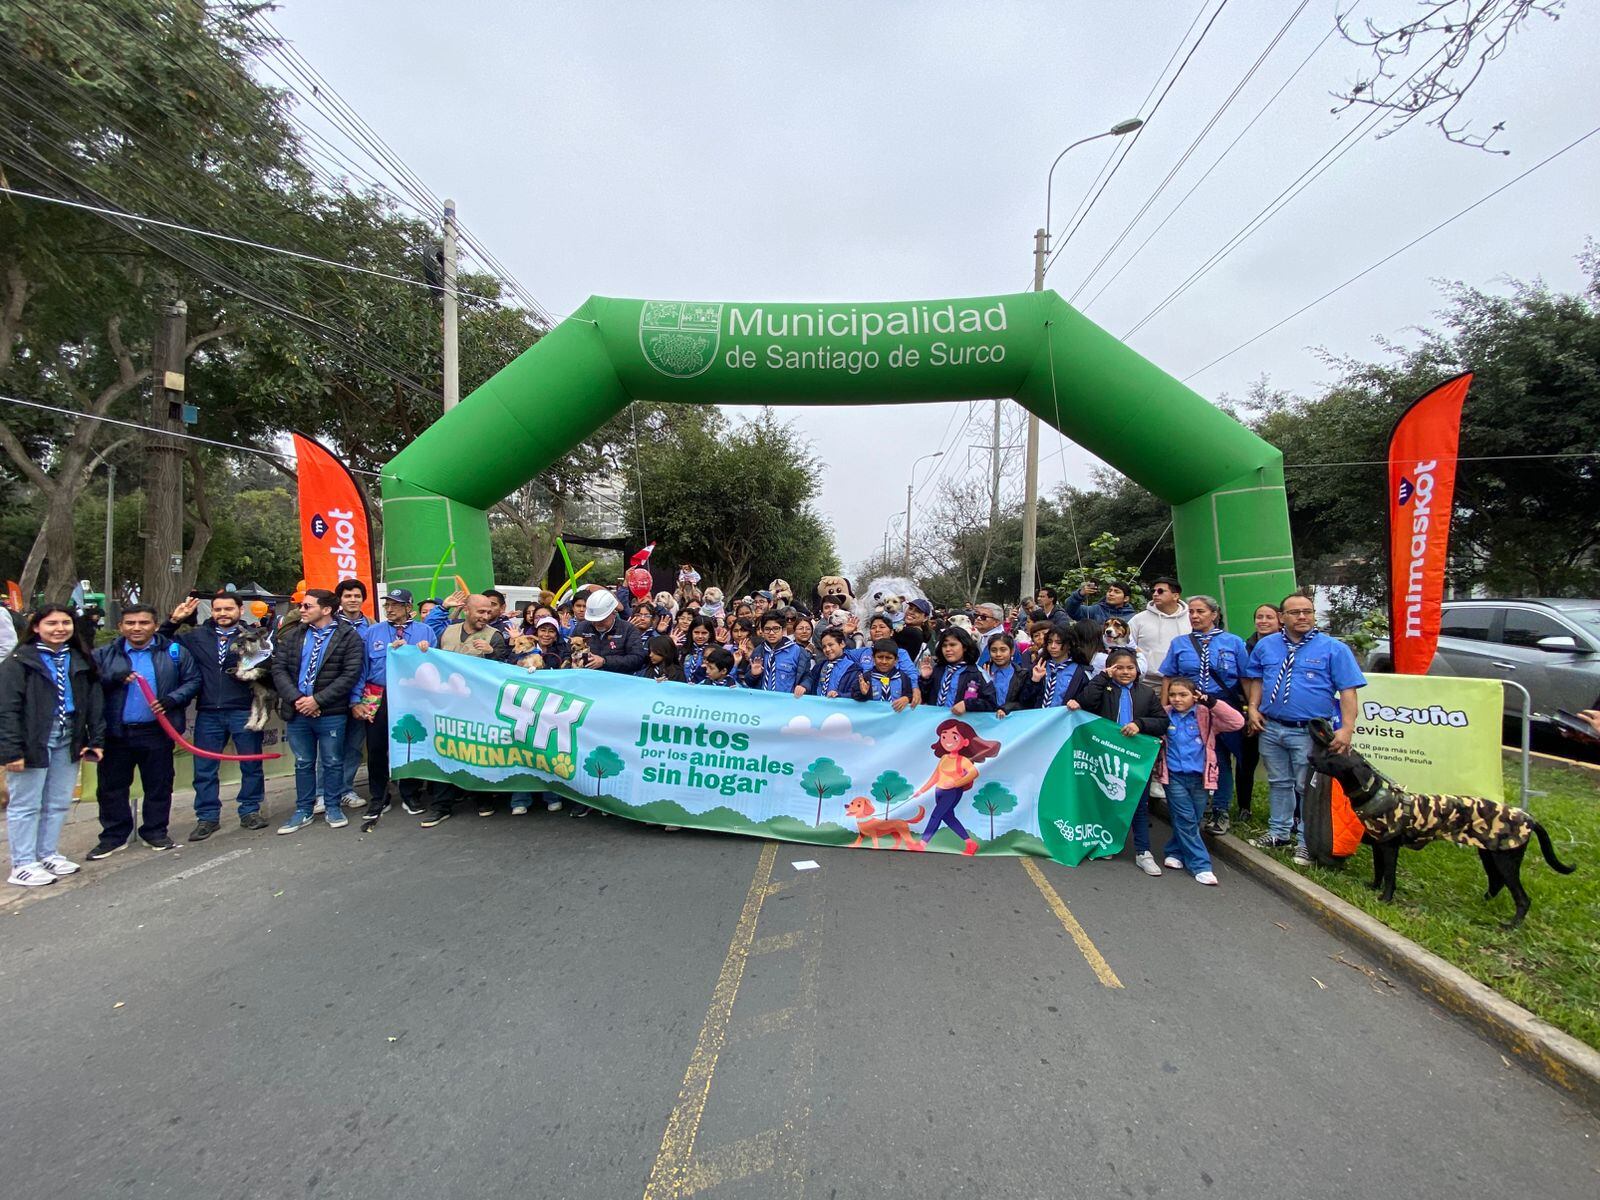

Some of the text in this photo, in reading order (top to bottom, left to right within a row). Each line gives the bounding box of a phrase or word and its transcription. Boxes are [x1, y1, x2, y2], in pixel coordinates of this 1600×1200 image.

[729, 303, 1008, 345] Municipalidad
[725, 341, 1007, 375] de Santiago de Surco
[315, 519, 323, 533] m
[1405, 460, 1437, 638] mimaskot
[499, 683, 587, 754] 4K
[652, 700, 761, 727] Caminemos
[1362, 701, 1469, 728] Pezuña
[435, 716, 513, 745] HUELLAS
[635, 714, 750, 751] juntos
[1352, 725, 1405, 739] evista
[435, 736, 551, 773] CAMINATA
[1100, 740, 1126, 754] alianza
[1359, 742, 1371, 750] QR
[1374, 753, 1403, 762] Tirando
[1404, 756, 1433, 766] Pezuña
[641, 748, 795, 776] por los animales
[642, 762, 768, 796] sin hogar
[1075, 823, 1114, 845] SURCO
